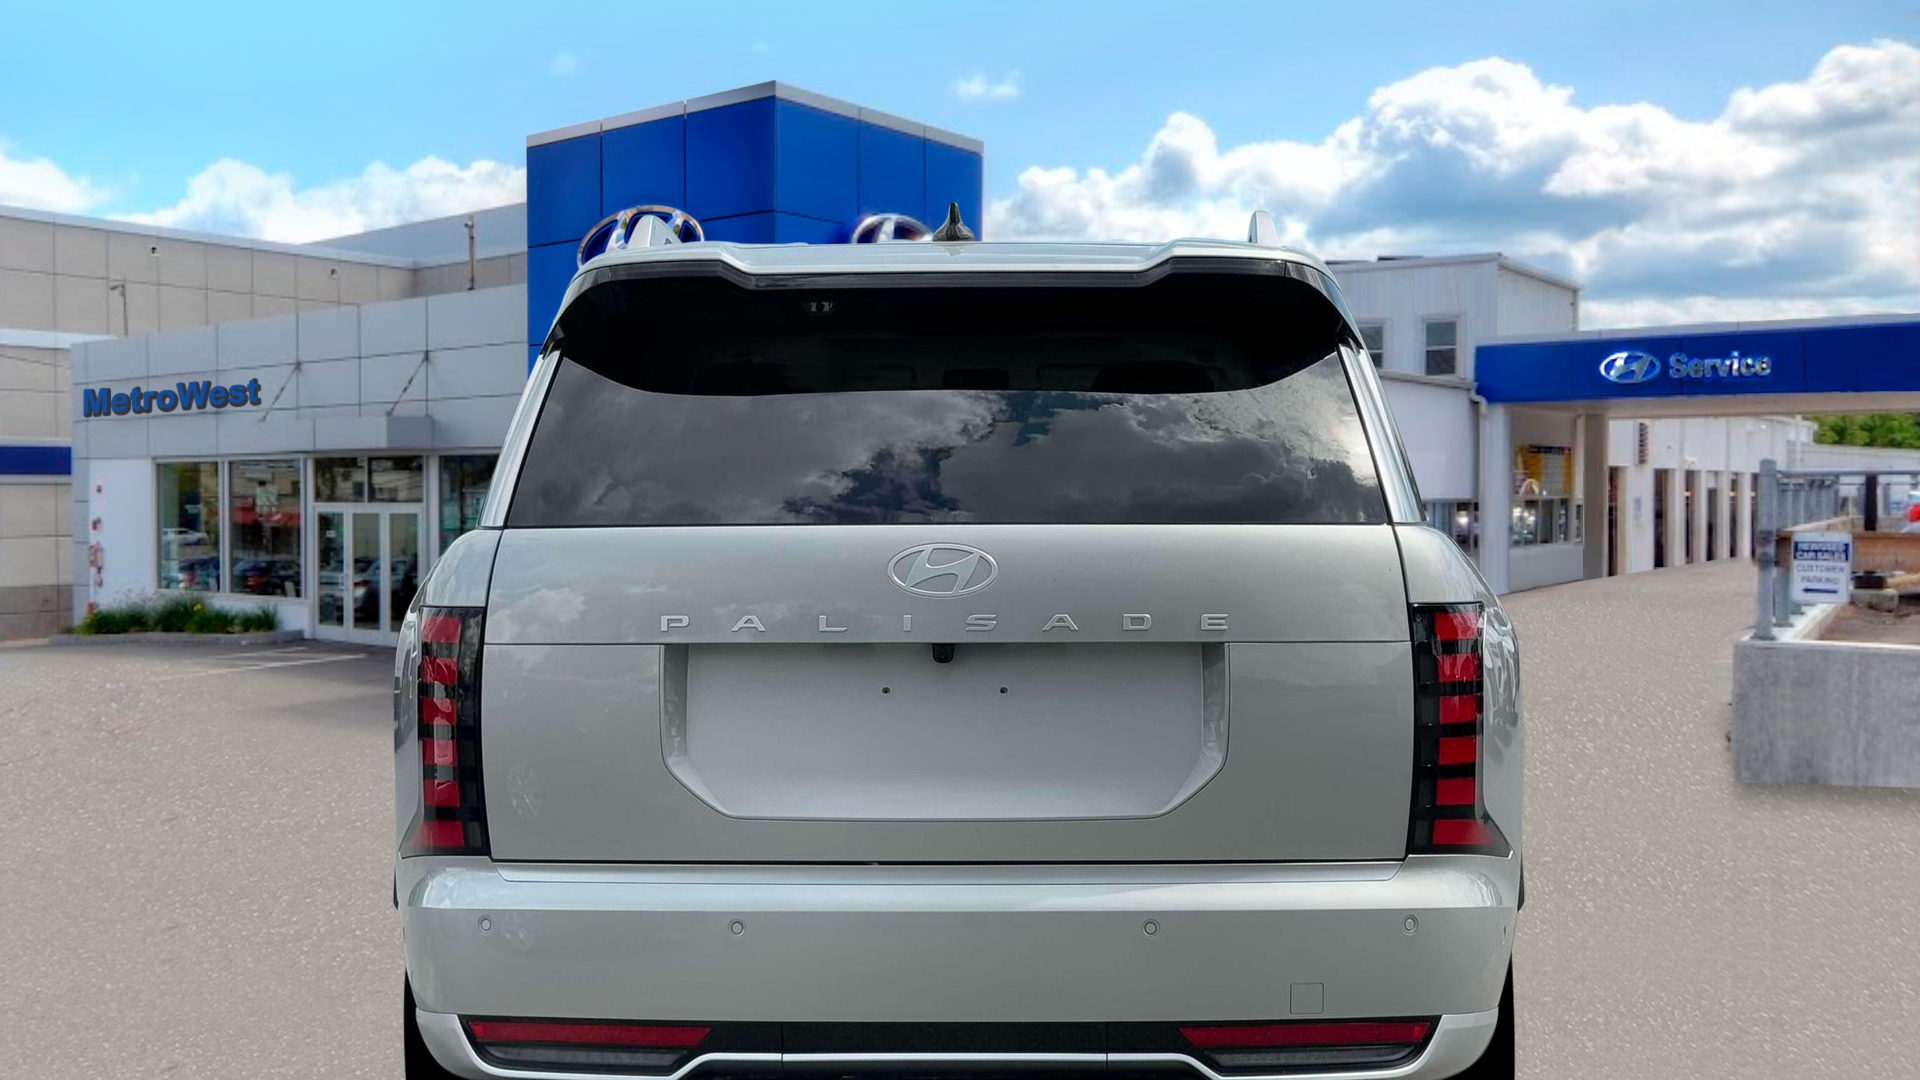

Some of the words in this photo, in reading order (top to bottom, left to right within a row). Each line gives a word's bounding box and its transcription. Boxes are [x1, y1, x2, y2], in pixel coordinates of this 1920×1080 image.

[1668, 351, 1772, 379] Service
[83, 378, 262, 418] MetroWest
[659, 612, 1229, 633] PALISADE
